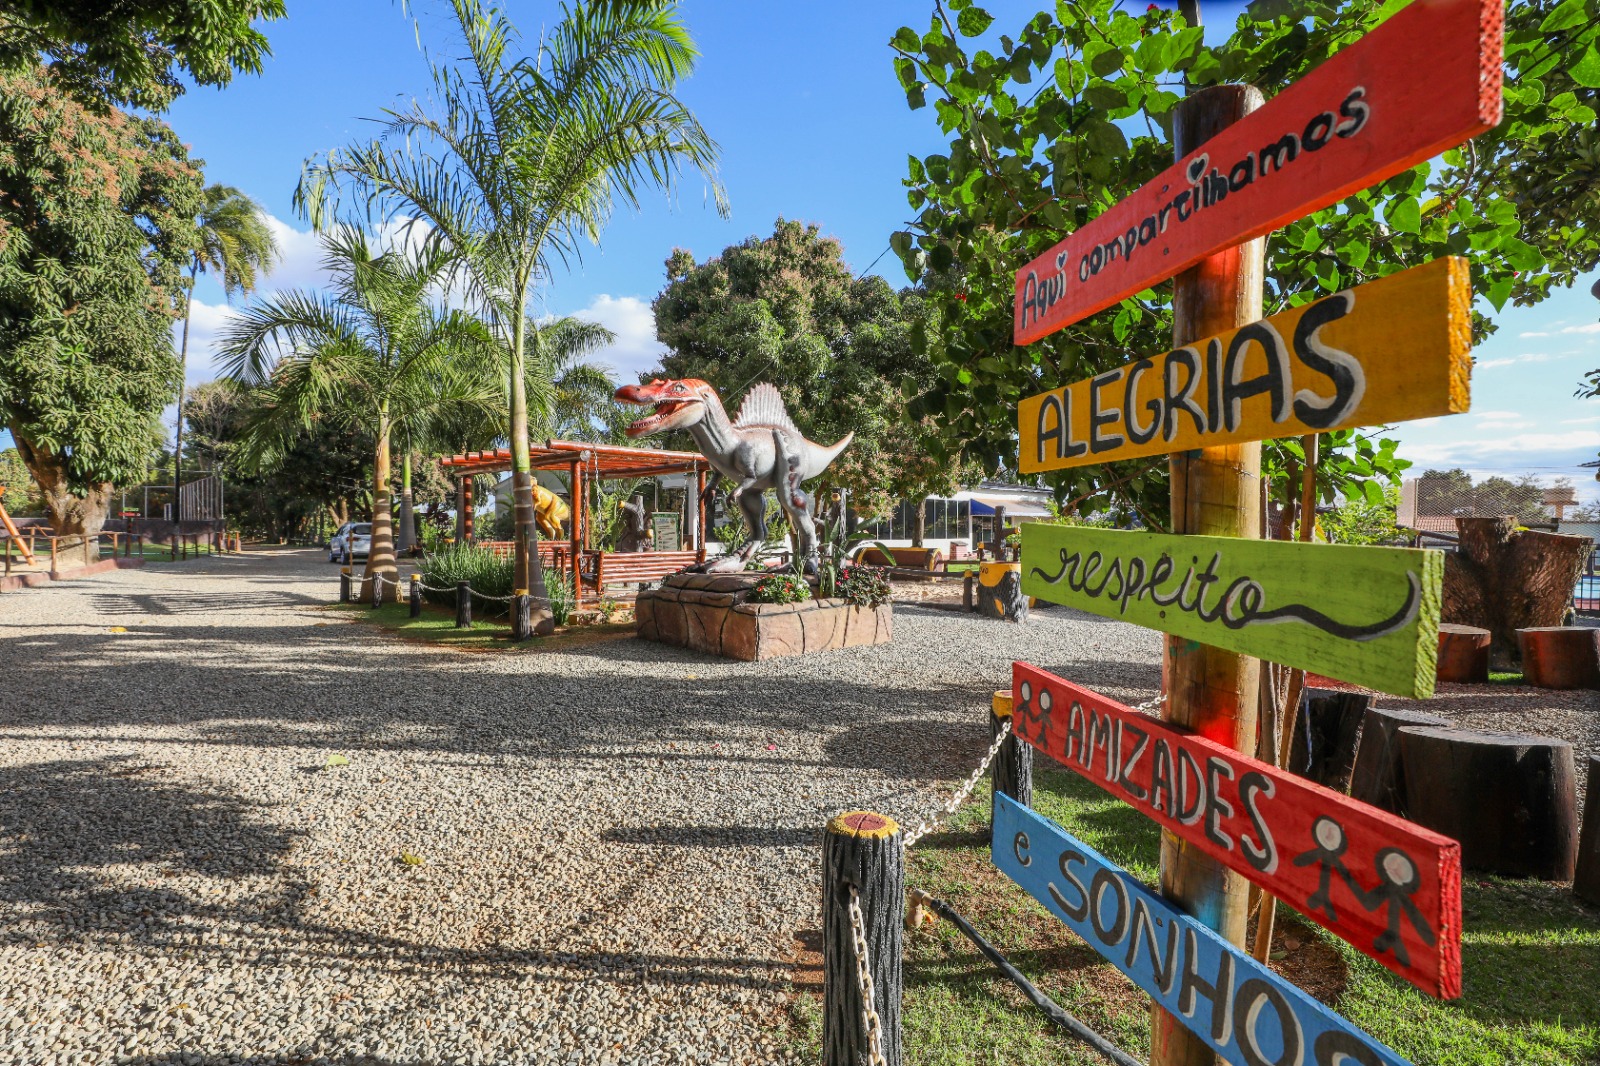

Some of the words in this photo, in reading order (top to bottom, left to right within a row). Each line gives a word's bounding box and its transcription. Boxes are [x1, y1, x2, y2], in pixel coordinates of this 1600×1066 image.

[1022, 250, 1068, 329] Aqui
[1079, 86, 1370, 282] compartilhamos
[1038, 289, 1366, 463] ALEGRIAS
[1030, 550, 1420, 641] respeito
[1013, 830, 1032, 868] e
[1065, 702, 1278, 875] AMIZADES
